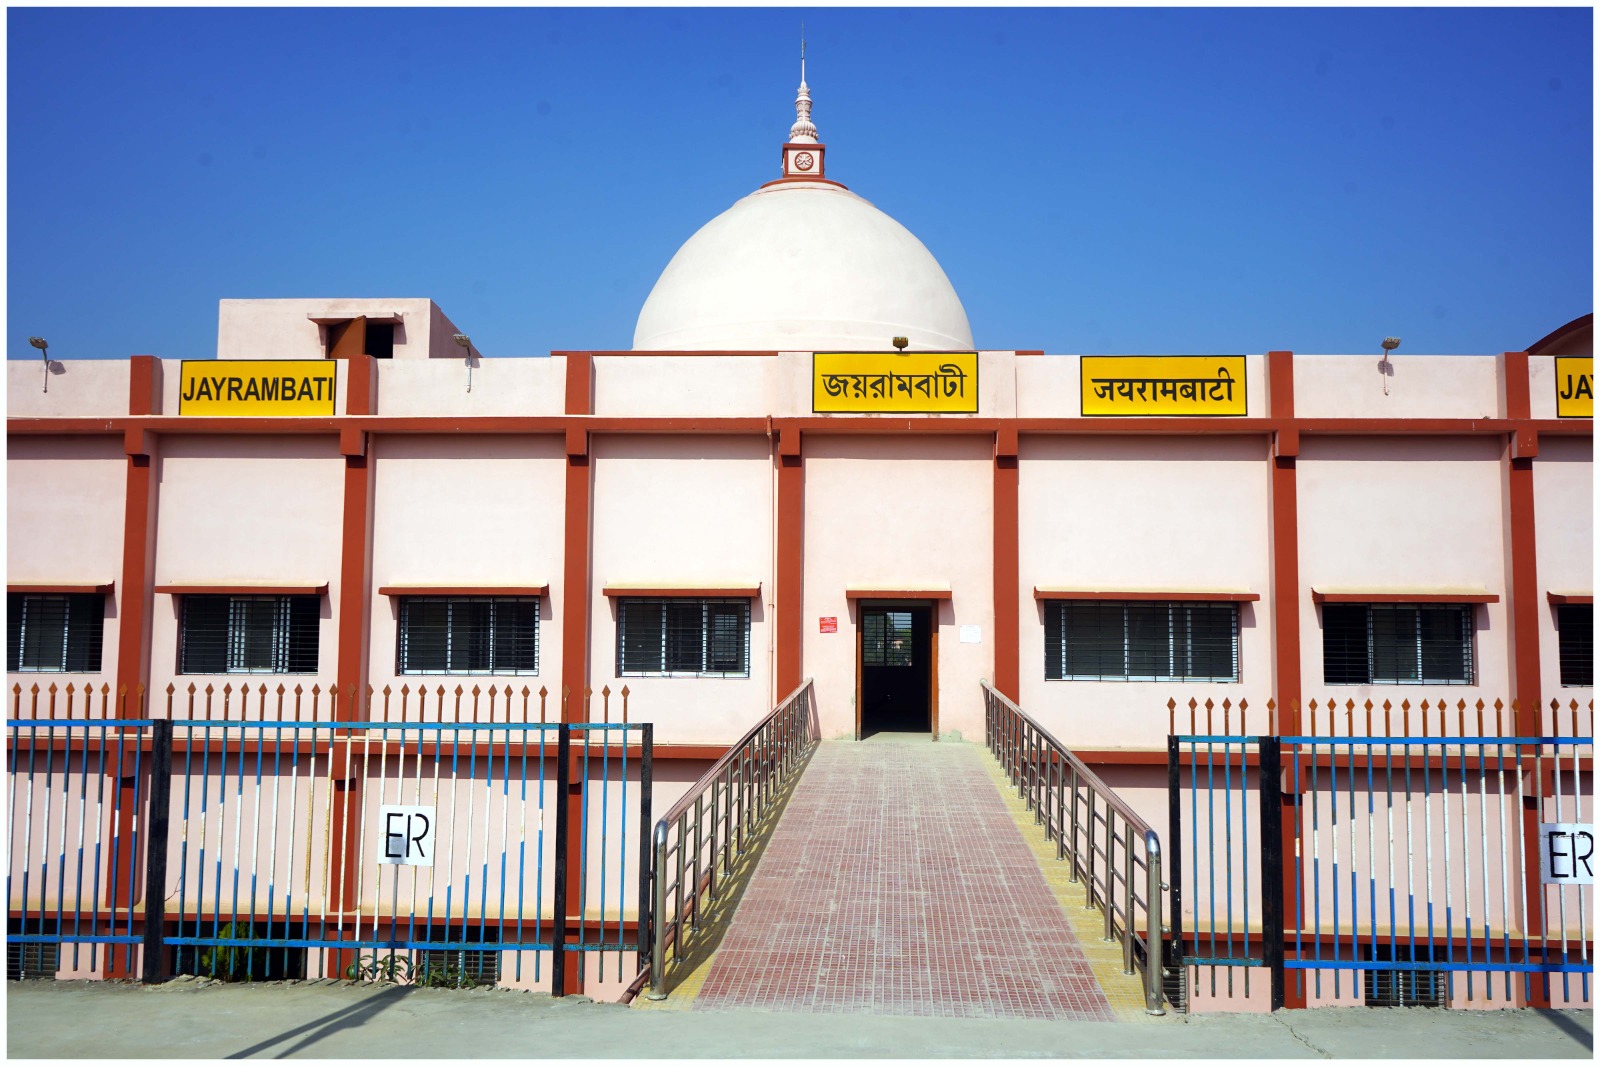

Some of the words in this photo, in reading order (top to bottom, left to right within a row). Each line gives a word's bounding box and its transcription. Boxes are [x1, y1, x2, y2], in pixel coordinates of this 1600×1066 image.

[182, 377, 334, 401] JAYRAMBATI
[821, 363, 968, 399] জয়রামবাটী
[1091, 366, 1236, 402] जयरामबाटी
[1560, 374, 1594, 400] JA
[385, 812, 430, 858] ER
